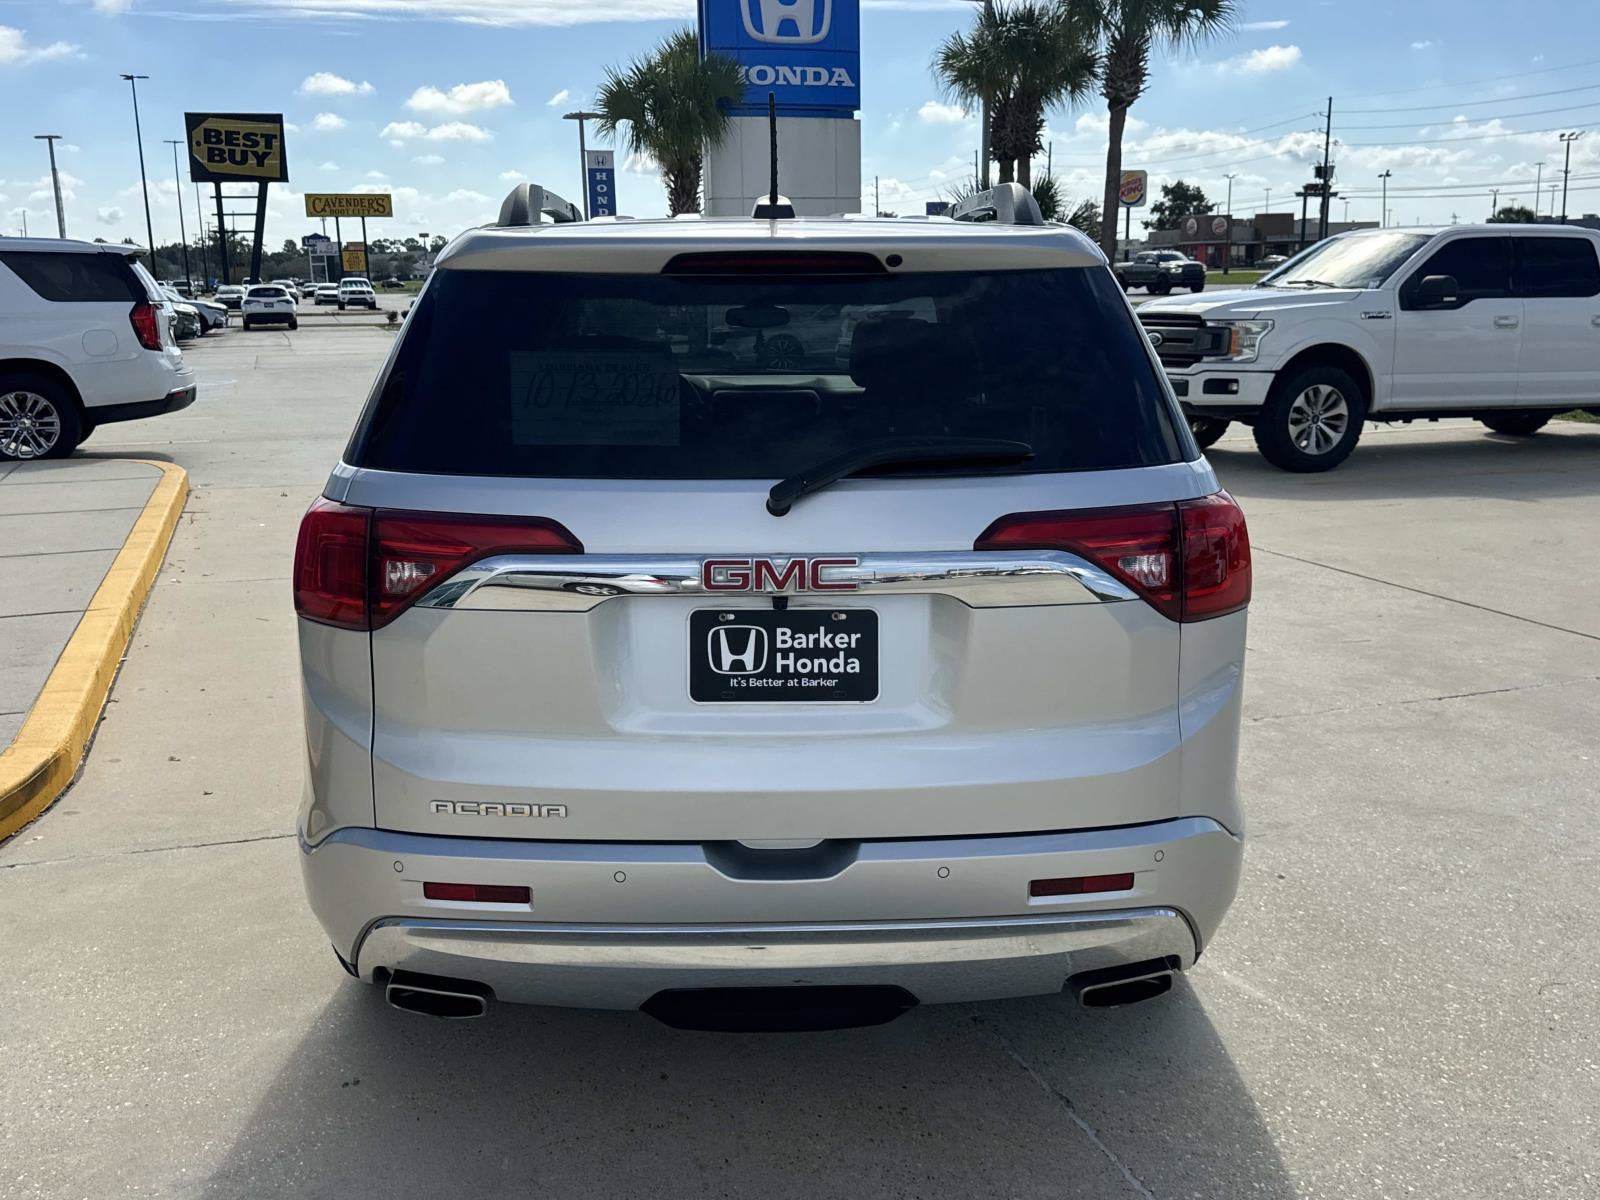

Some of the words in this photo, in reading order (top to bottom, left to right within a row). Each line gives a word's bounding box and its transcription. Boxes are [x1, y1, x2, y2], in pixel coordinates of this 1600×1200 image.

[203, 128, 277, 150] BEST
[207, 146, 272, 168] BUY
[312, 197, 385, 214] CAVENDER'S
[702, 557, 860, 593] GMC
[776, 626, 861, 649] Barker
[776, 650, 861, 674] Honda
[729, 677, 747, 688] It's
[749, 677, 785, 688] Better
[787, 678, 799, 688] at
[801, 677, 838, 688] Barker
[429, 800, 568, 818] ACADIA
